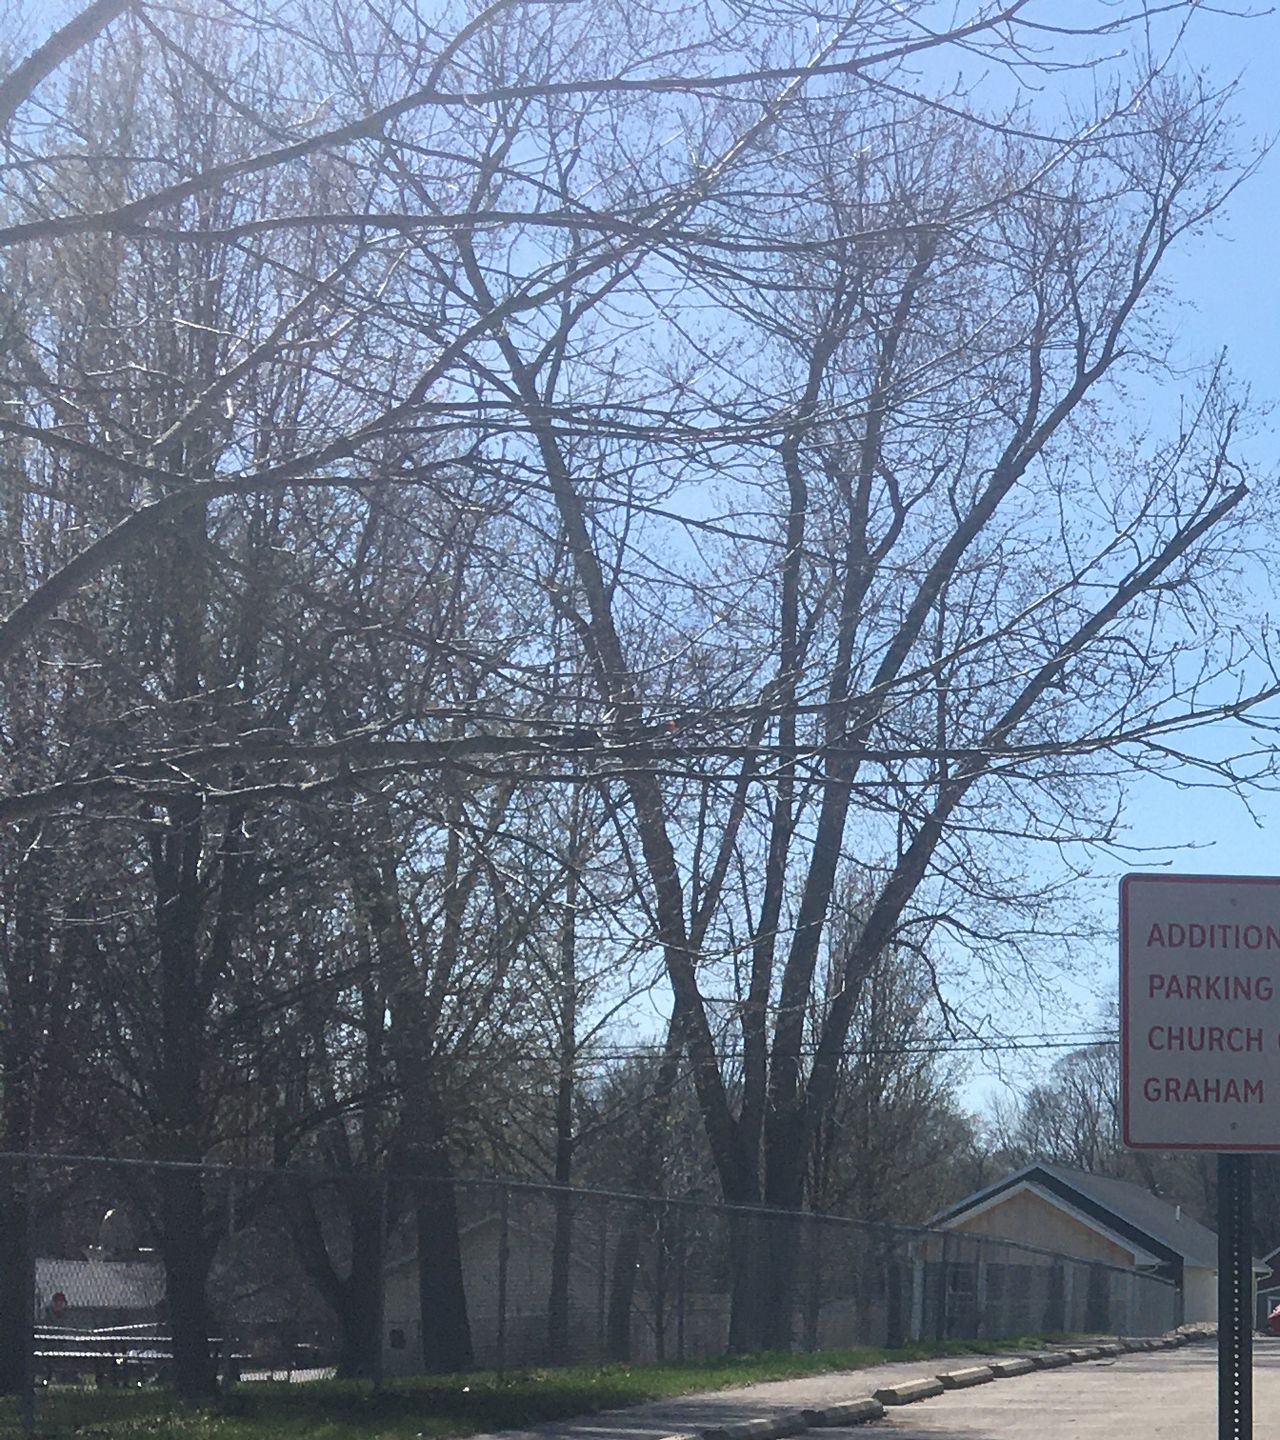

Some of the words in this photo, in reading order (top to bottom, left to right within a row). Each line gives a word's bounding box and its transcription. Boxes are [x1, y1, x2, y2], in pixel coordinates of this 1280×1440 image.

[1148, 974, 1273, 1001] PARKING
[1147, 1026, 1264, 1052] CHURCH
[1143, 1077, 1264, 1103] GRAHAM
